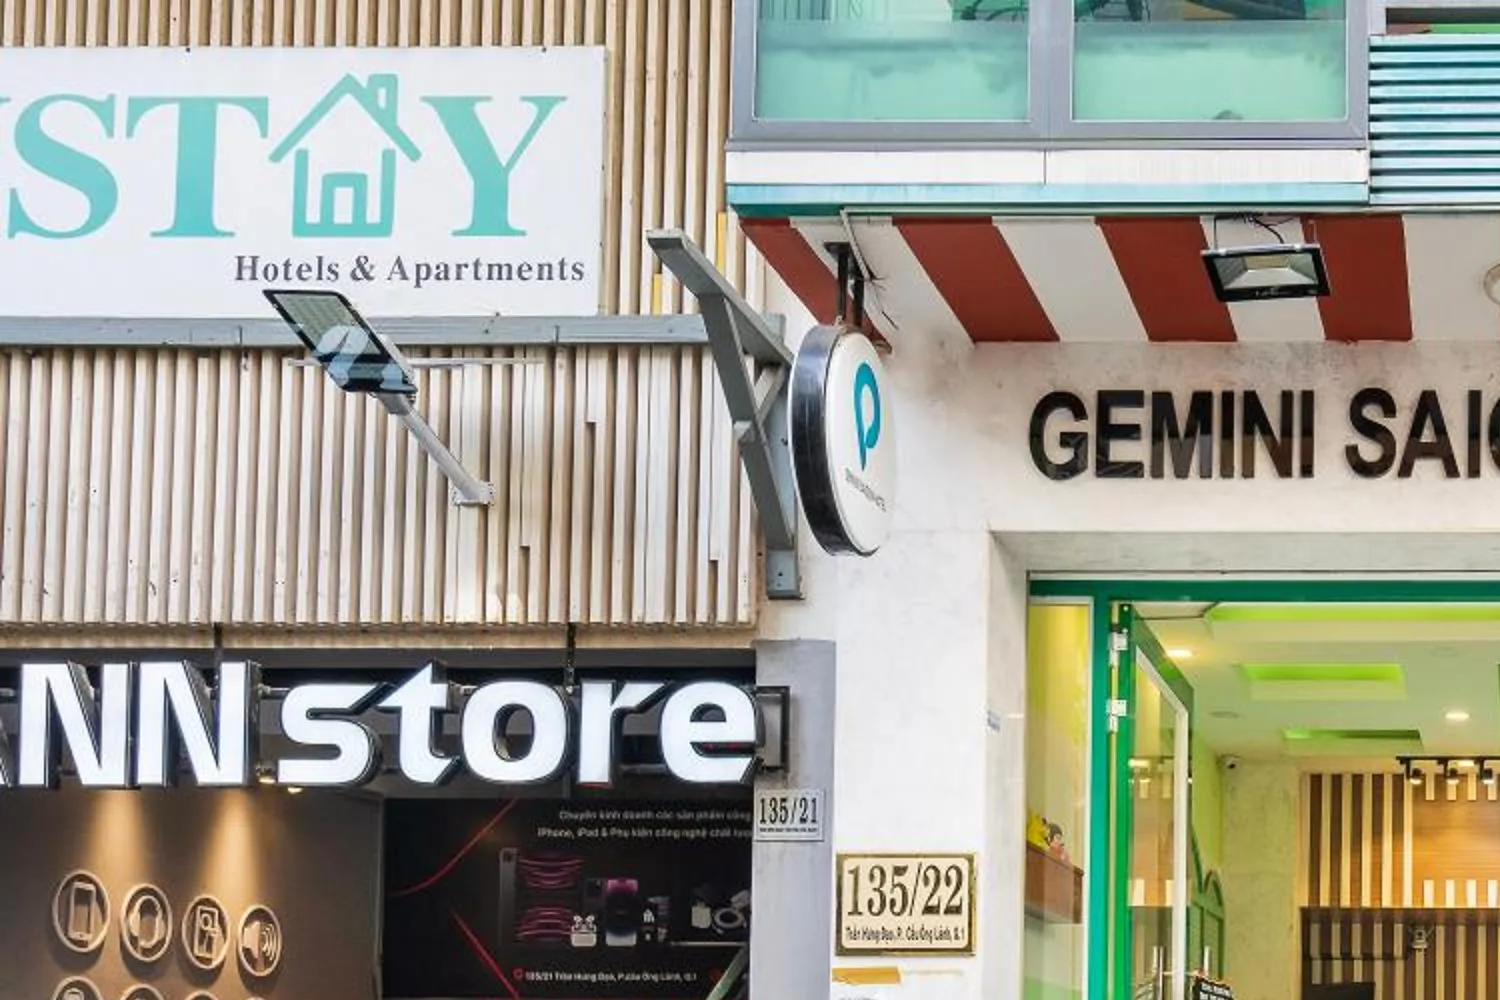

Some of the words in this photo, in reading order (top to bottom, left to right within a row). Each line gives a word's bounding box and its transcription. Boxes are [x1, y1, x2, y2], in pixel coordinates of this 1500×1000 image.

[234, 254, 341, 282] Hotels
[350, 255, 377, 282] &
[386, 254, 586, 289] Apartments
[1028, 389, 1316, 480] GEMINI
[0, 661, 256, 788] NN
[276, 660, 760, 786] store
[759, 797, 817, 824] 135/21
[847, 862, 963, 916] 135/22
